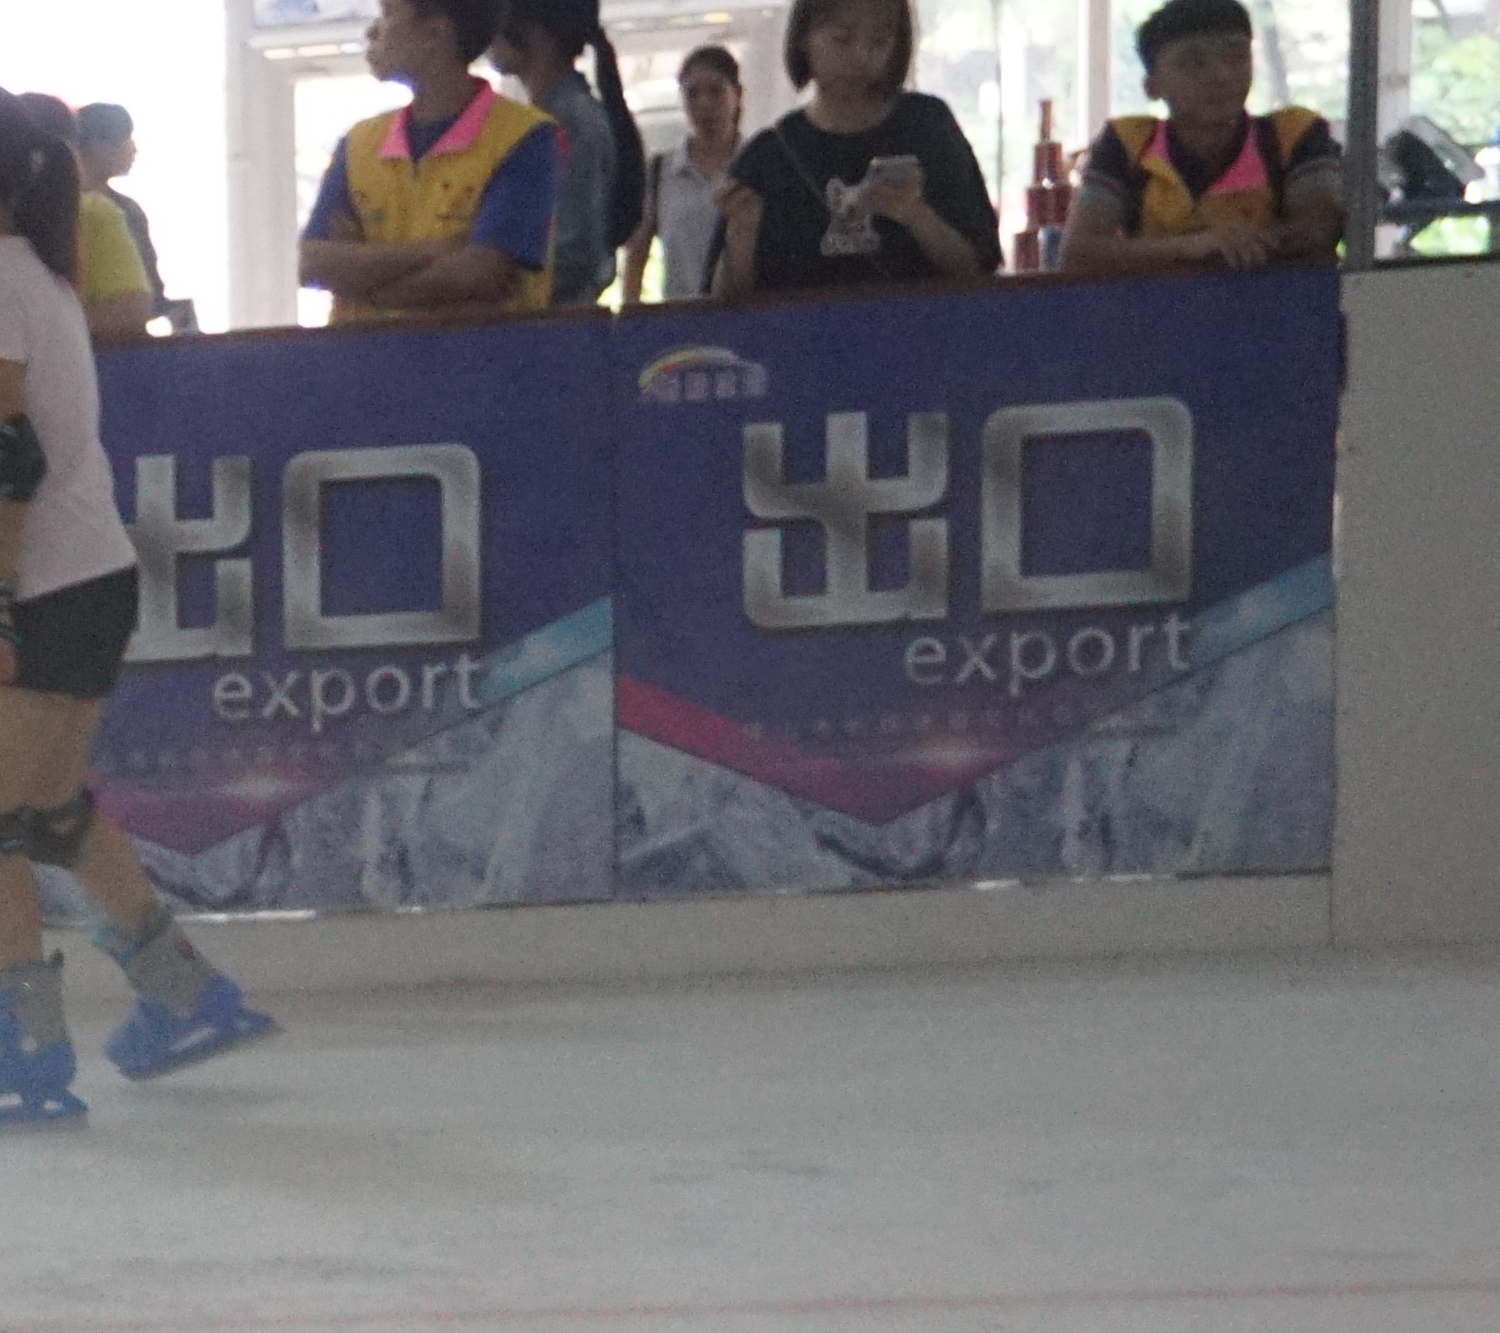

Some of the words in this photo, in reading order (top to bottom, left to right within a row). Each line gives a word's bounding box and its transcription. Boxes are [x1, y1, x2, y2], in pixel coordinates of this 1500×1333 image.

[743, 397, 1193, 629] 出口
[213, 652, 487, 731] export
[905, 612, 1193, 696] export
